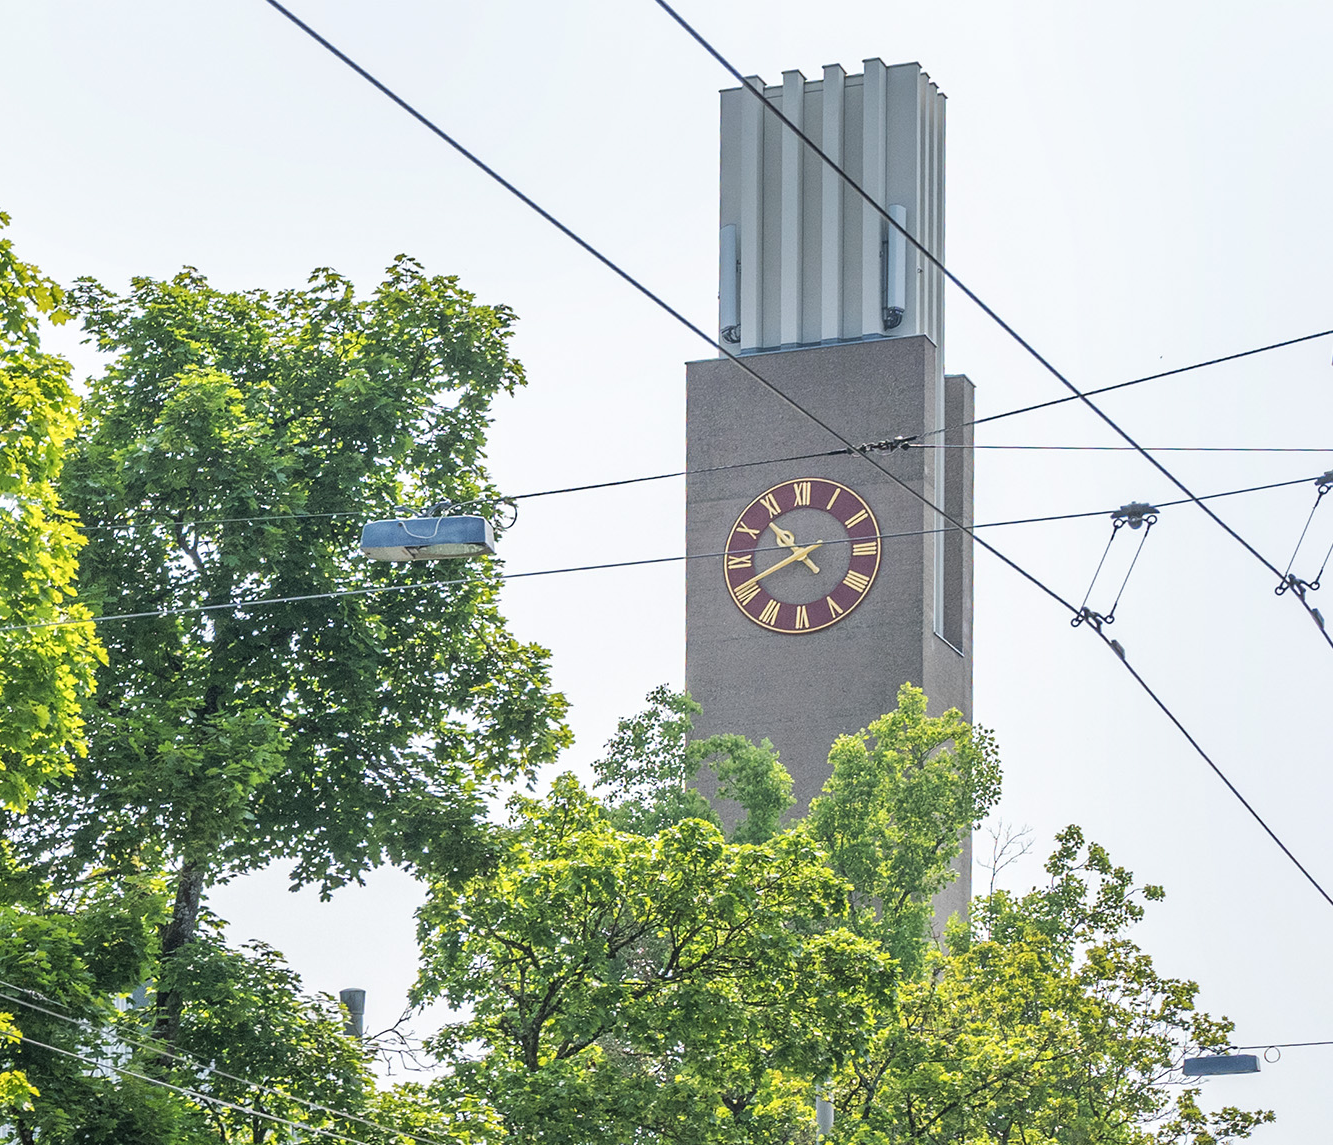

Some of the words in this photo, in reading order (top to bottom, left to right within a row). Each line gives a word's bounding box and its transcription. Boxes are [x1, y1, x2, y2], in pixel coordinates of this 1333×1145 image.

[793, 482, 811, 507] XII
[826, 488, 841, 510] I
[760, 493, 782, 519] XI
[845, 509, 868, 529] II
[736, 521, 760, 540] X
[852, 541, 877, 556] III
[727, 554, 752, 569] IX
[758, 599, 781, 626] VII
[795, 605, 810, 629] VI
[826, 596, 844, 619] V
